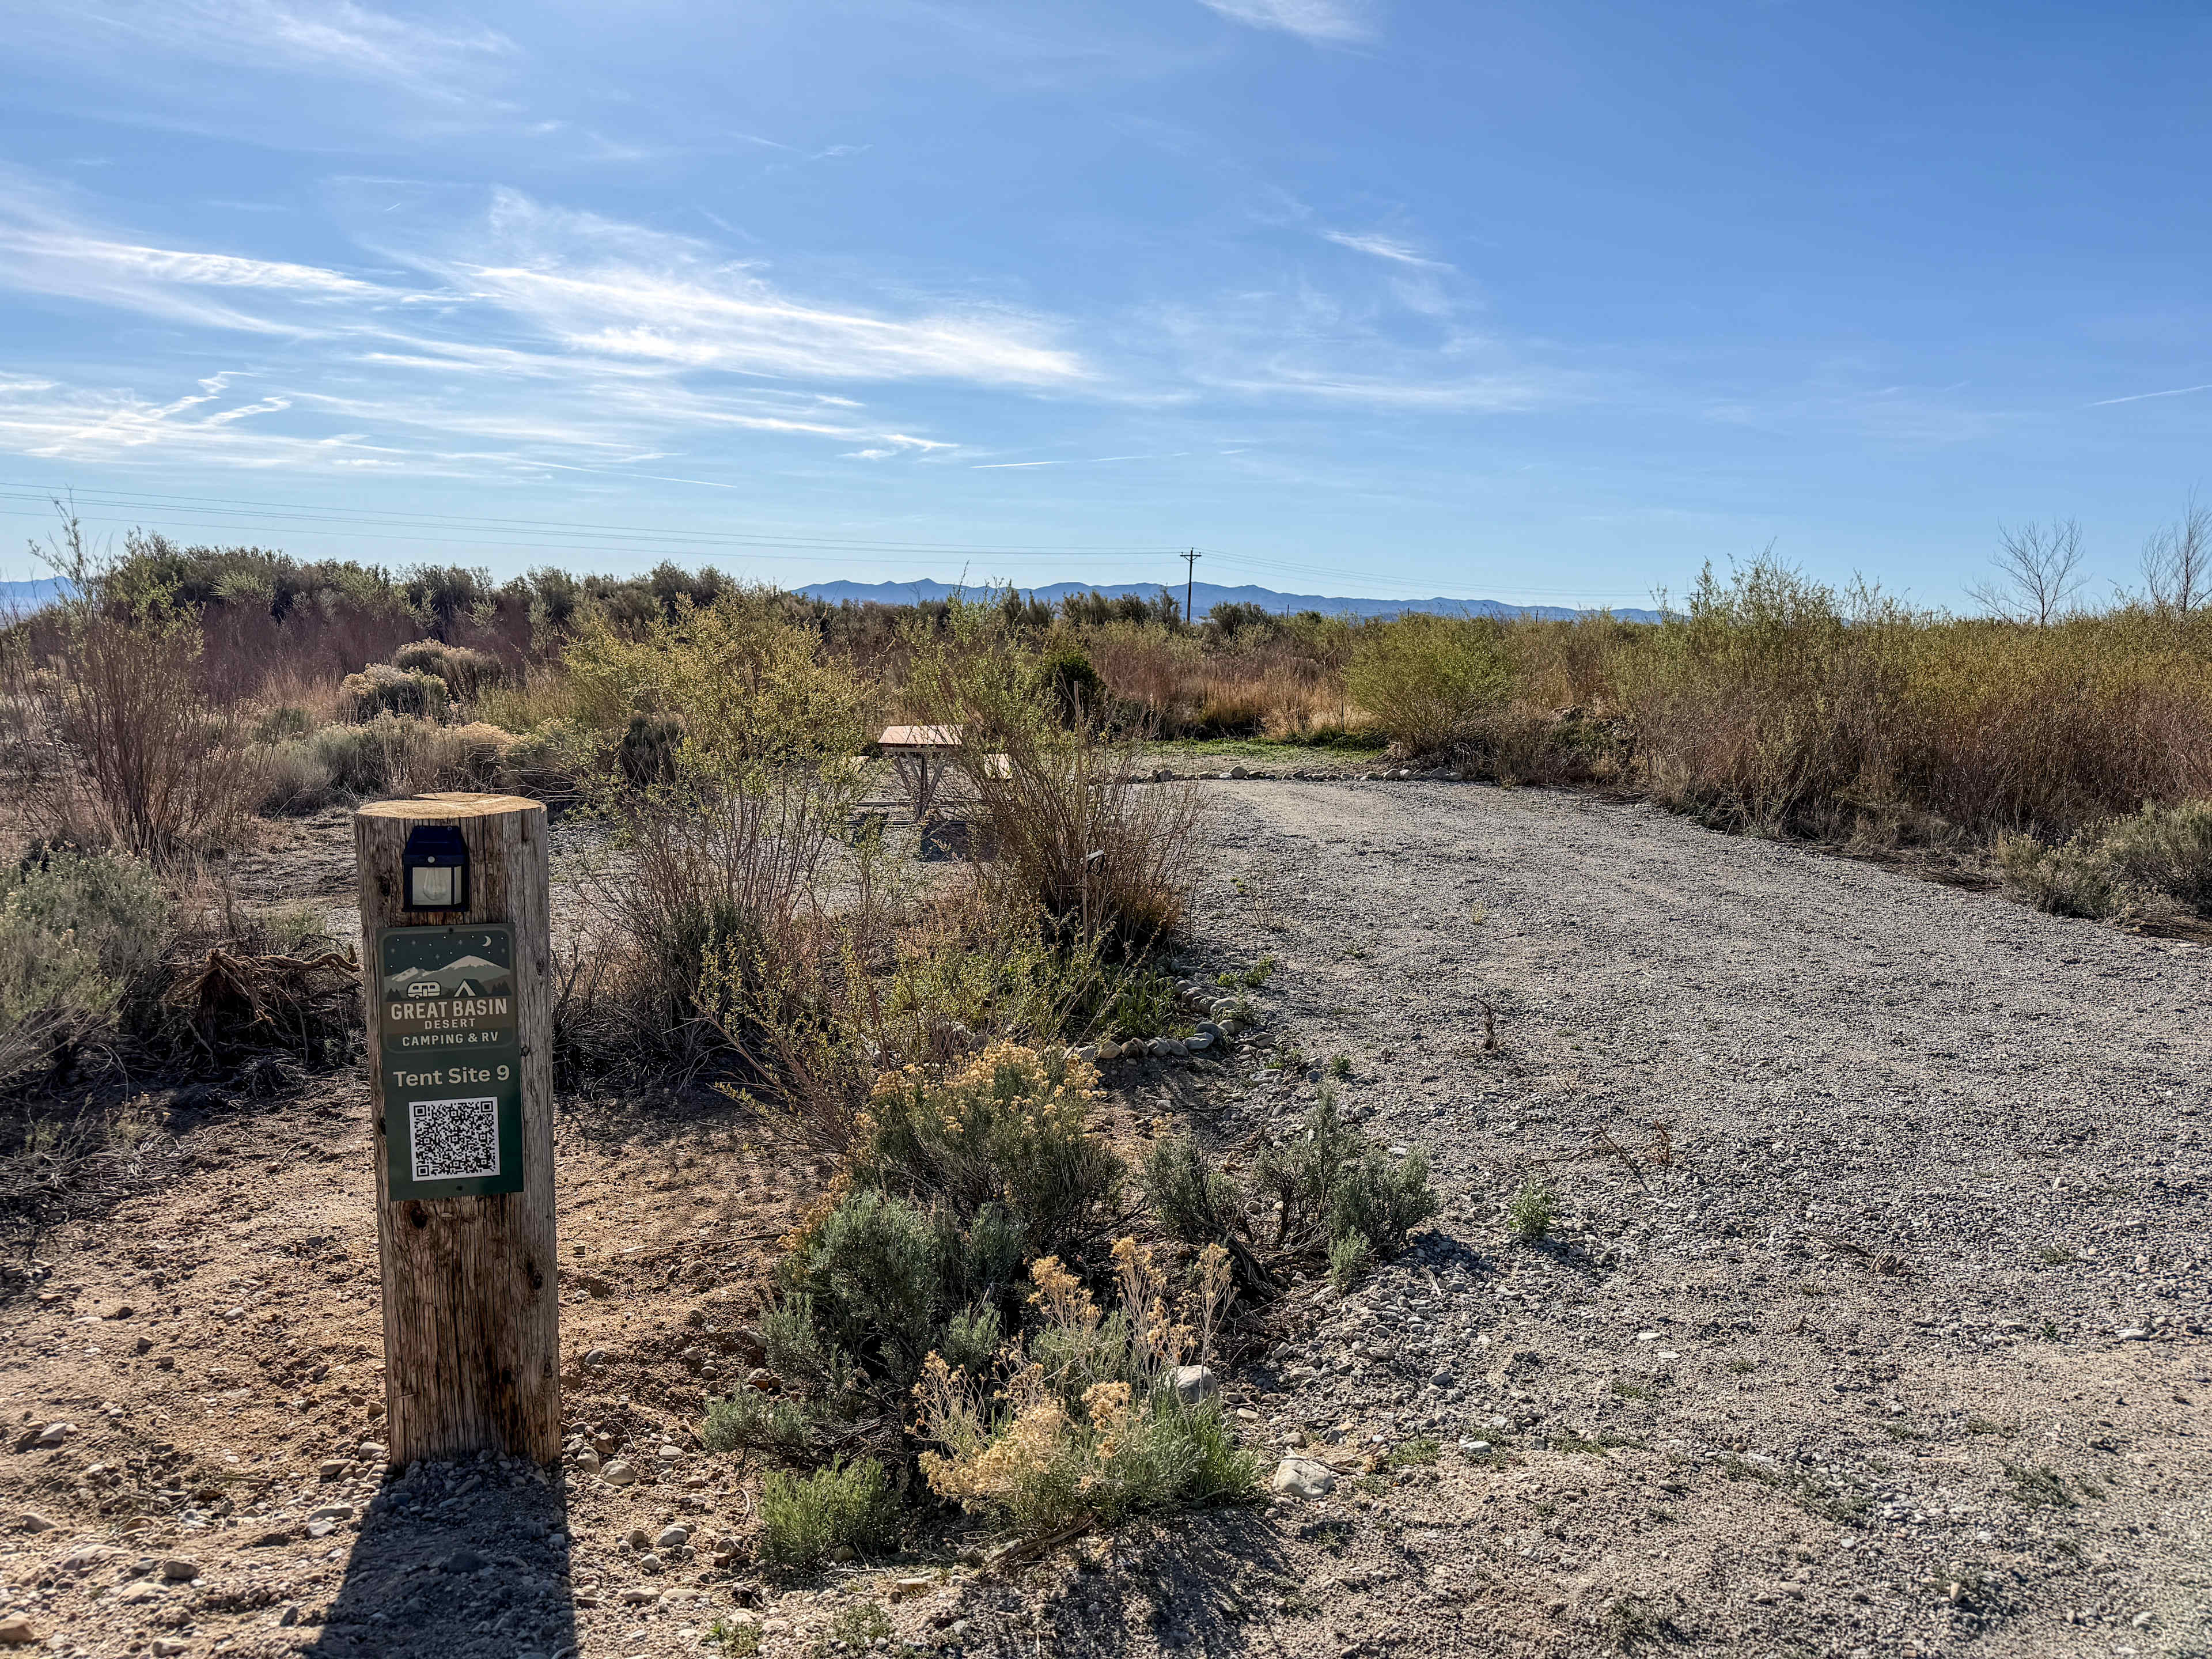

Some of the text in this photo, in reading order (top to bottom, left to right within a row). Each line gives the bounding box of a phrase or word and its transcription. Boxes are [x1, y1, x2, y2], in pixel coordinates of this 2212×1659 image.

[391, 998, 507, 1020] GREAT BASIN
[425, 1018, 475, 1029] DESERT
[402, 1032, 498, 1047] CAMPING & RV
[393, 1065, 510, 1087] Tent Site 9
